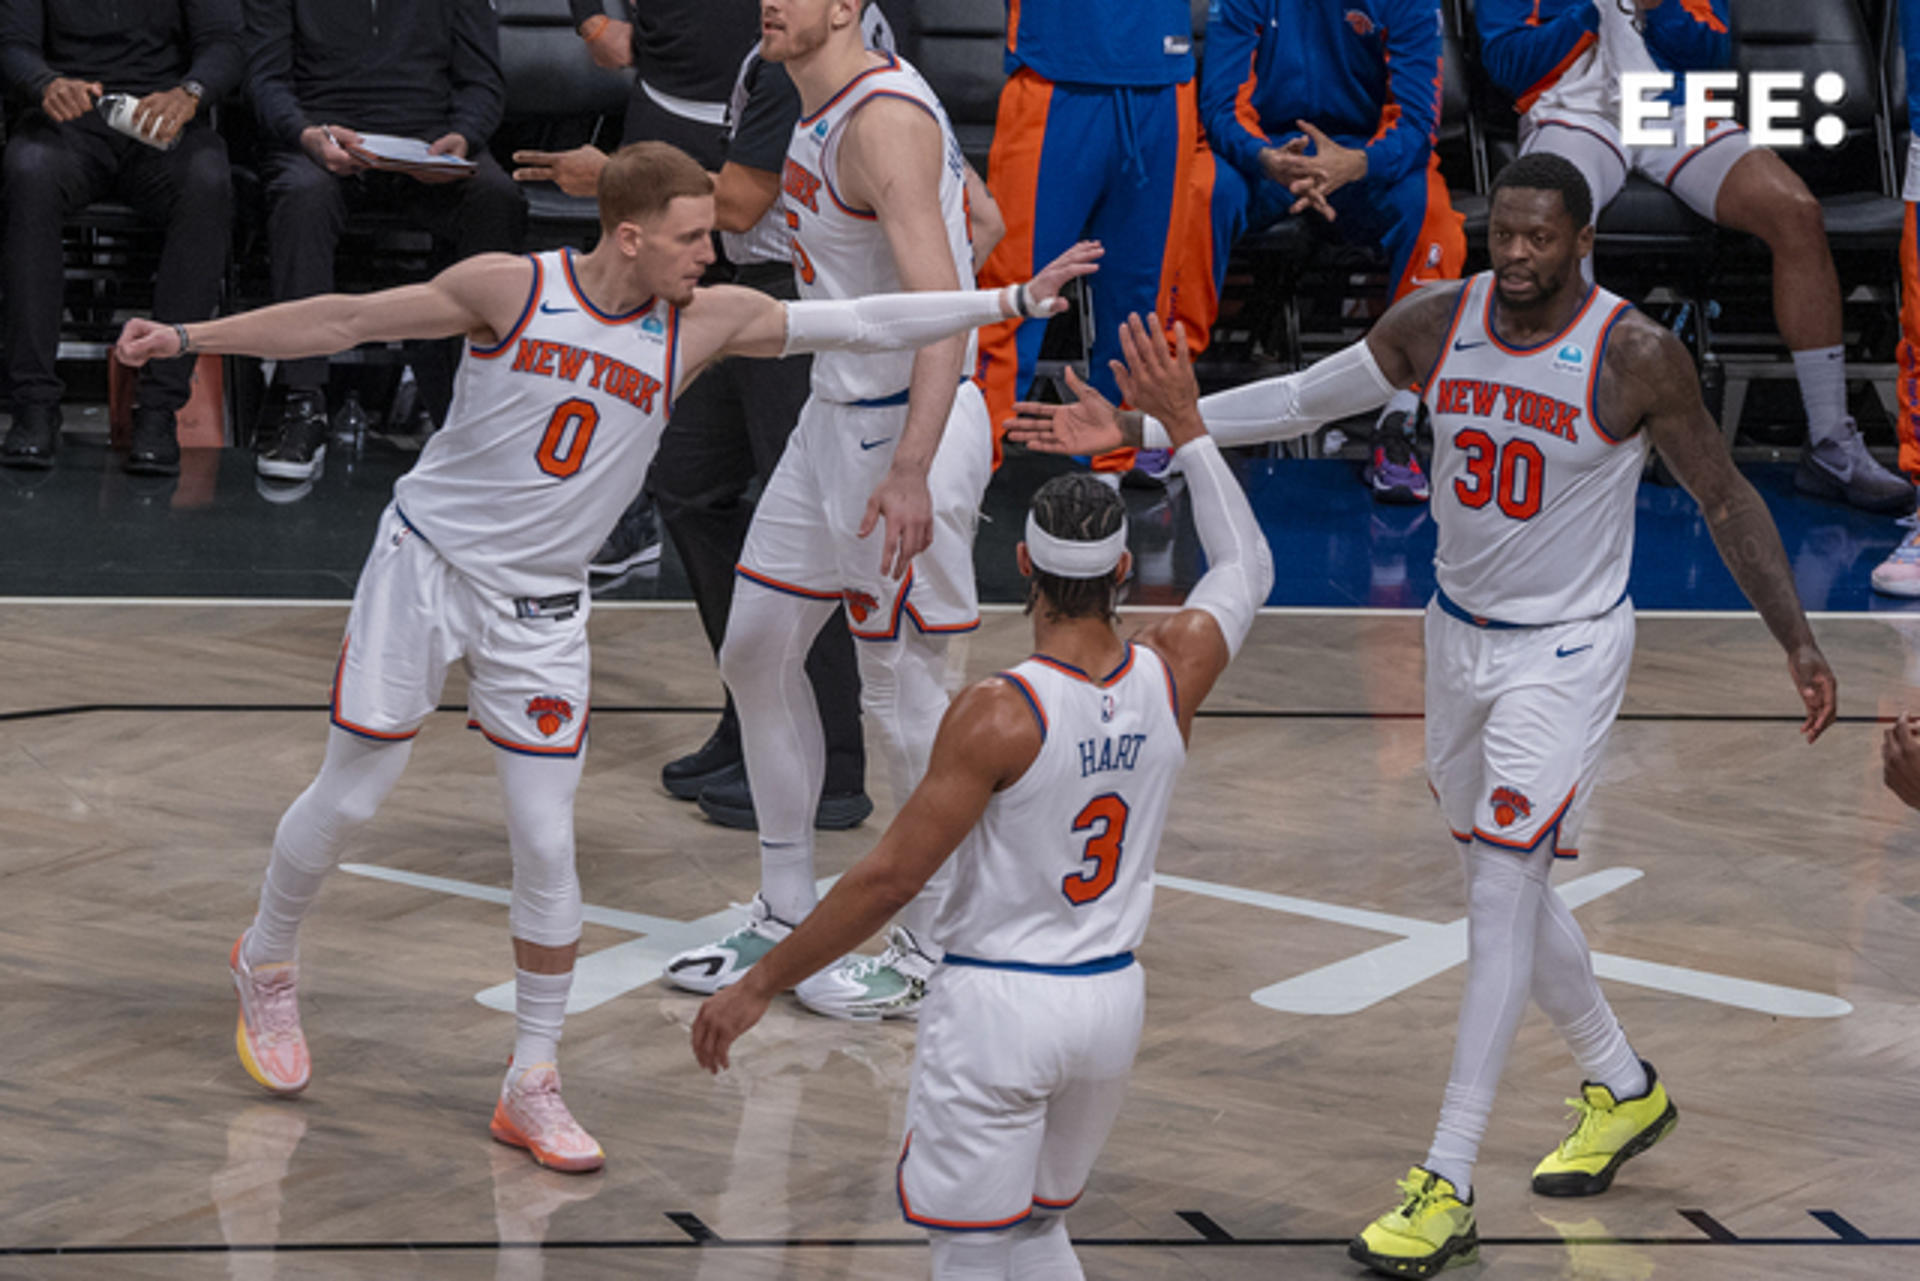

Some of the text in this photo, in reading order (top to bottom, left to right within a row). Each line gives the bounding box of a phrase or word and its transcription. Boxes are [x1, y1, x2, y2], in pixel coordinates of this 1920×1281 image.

[511, 338, 664, 416] NEW YORK
[1436, 378, 1582, 443] NEW YORK
[535, 396, 601, 481] 0
[1453, 426, 1546, 522] 30
[1078, 733, 1147, 778] HART
[1061, 791, 1130, 908] 3
